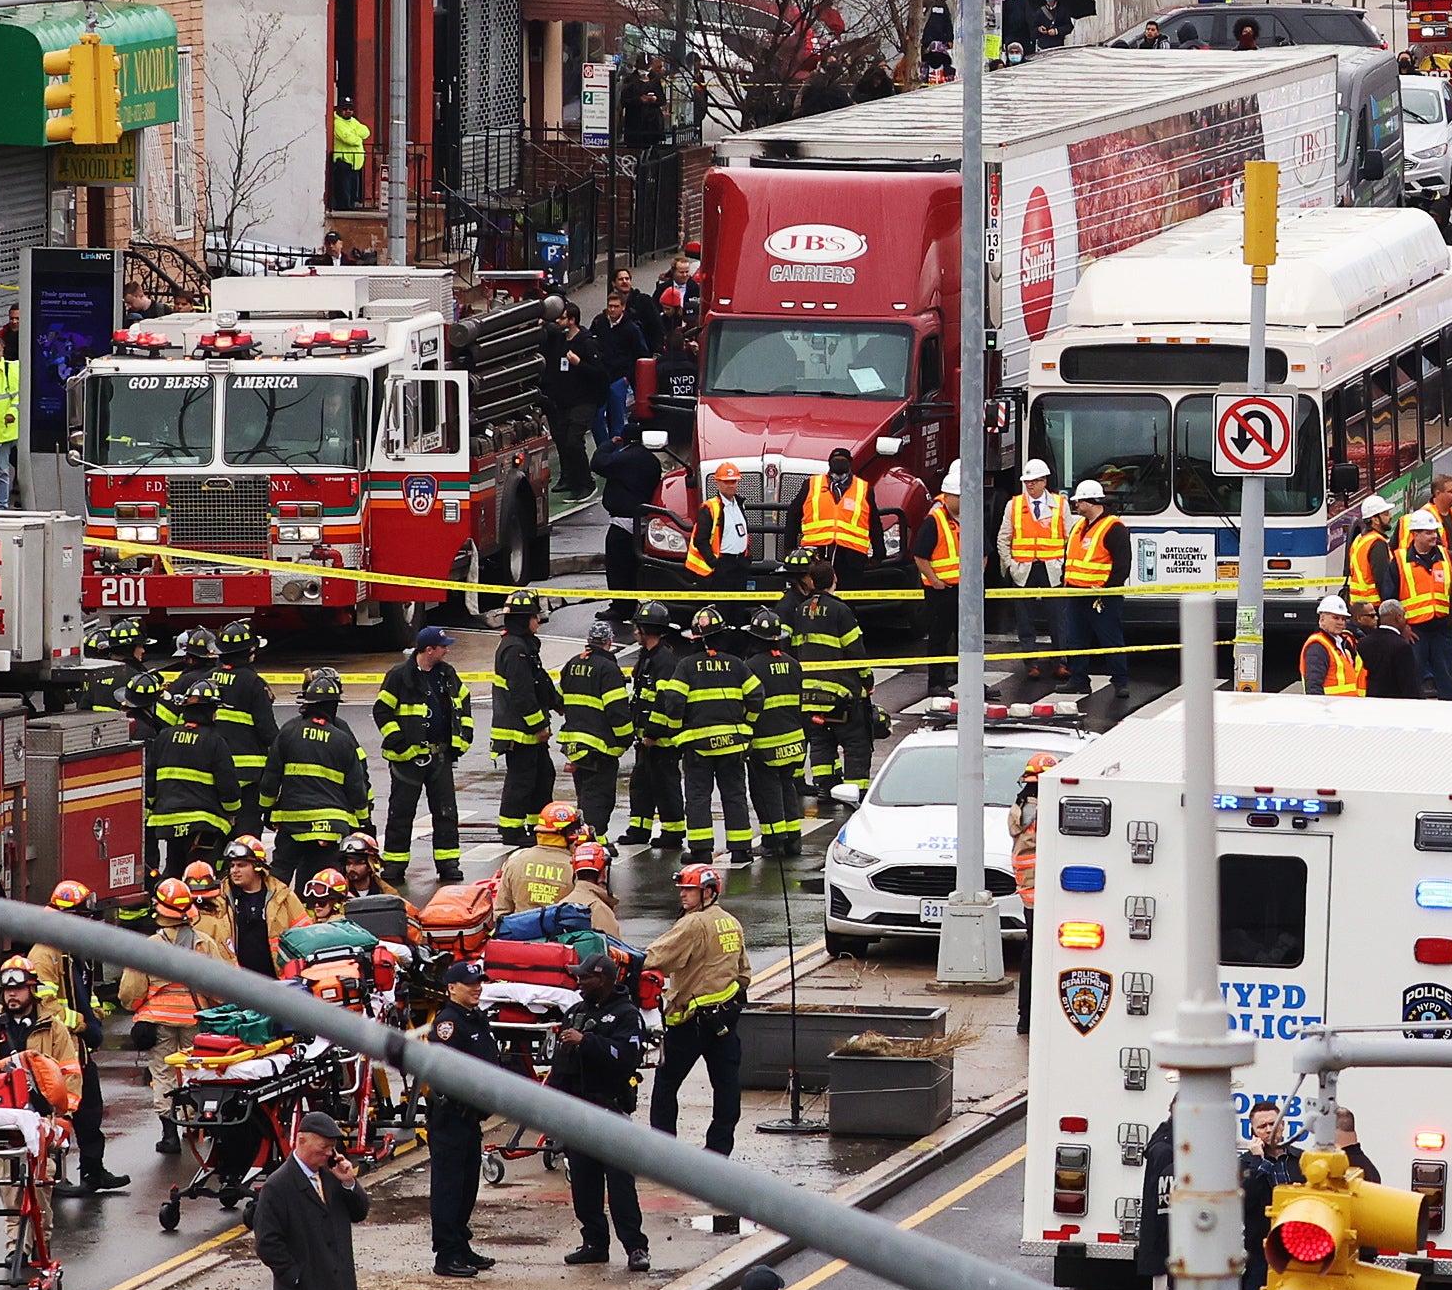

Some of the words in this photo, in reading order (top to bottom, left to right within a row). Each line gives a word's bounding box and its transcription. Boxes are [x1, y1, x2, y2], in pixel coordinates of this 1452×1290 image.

[769, 264, 856, 285] CARRIERS
[129, 377, 157, 389] GOD
[164, 377, 209, 389] BLESS
[232, 377, 298, 390] AMERICA
[146, 481, 165, 493] F.D.
[271, 481, 293, 493] N.Y.
[1165, 546, 1202, 554] OATLY.COM/
[1160, 553, 1208, 561] INFREQUENTLY
[1165, 566, 1202, 574] QUESTIONS
[101, 578, 147, 606] 201
[527, 882, 560, 894] RESCUE
[530, 893, 555, 904] MEDIC
[1071, 970, 1100, 980] POLICE
[1405, 986, 1452, 1007] POLICE
[1415, 1002, 1442, 1014] NYPD
